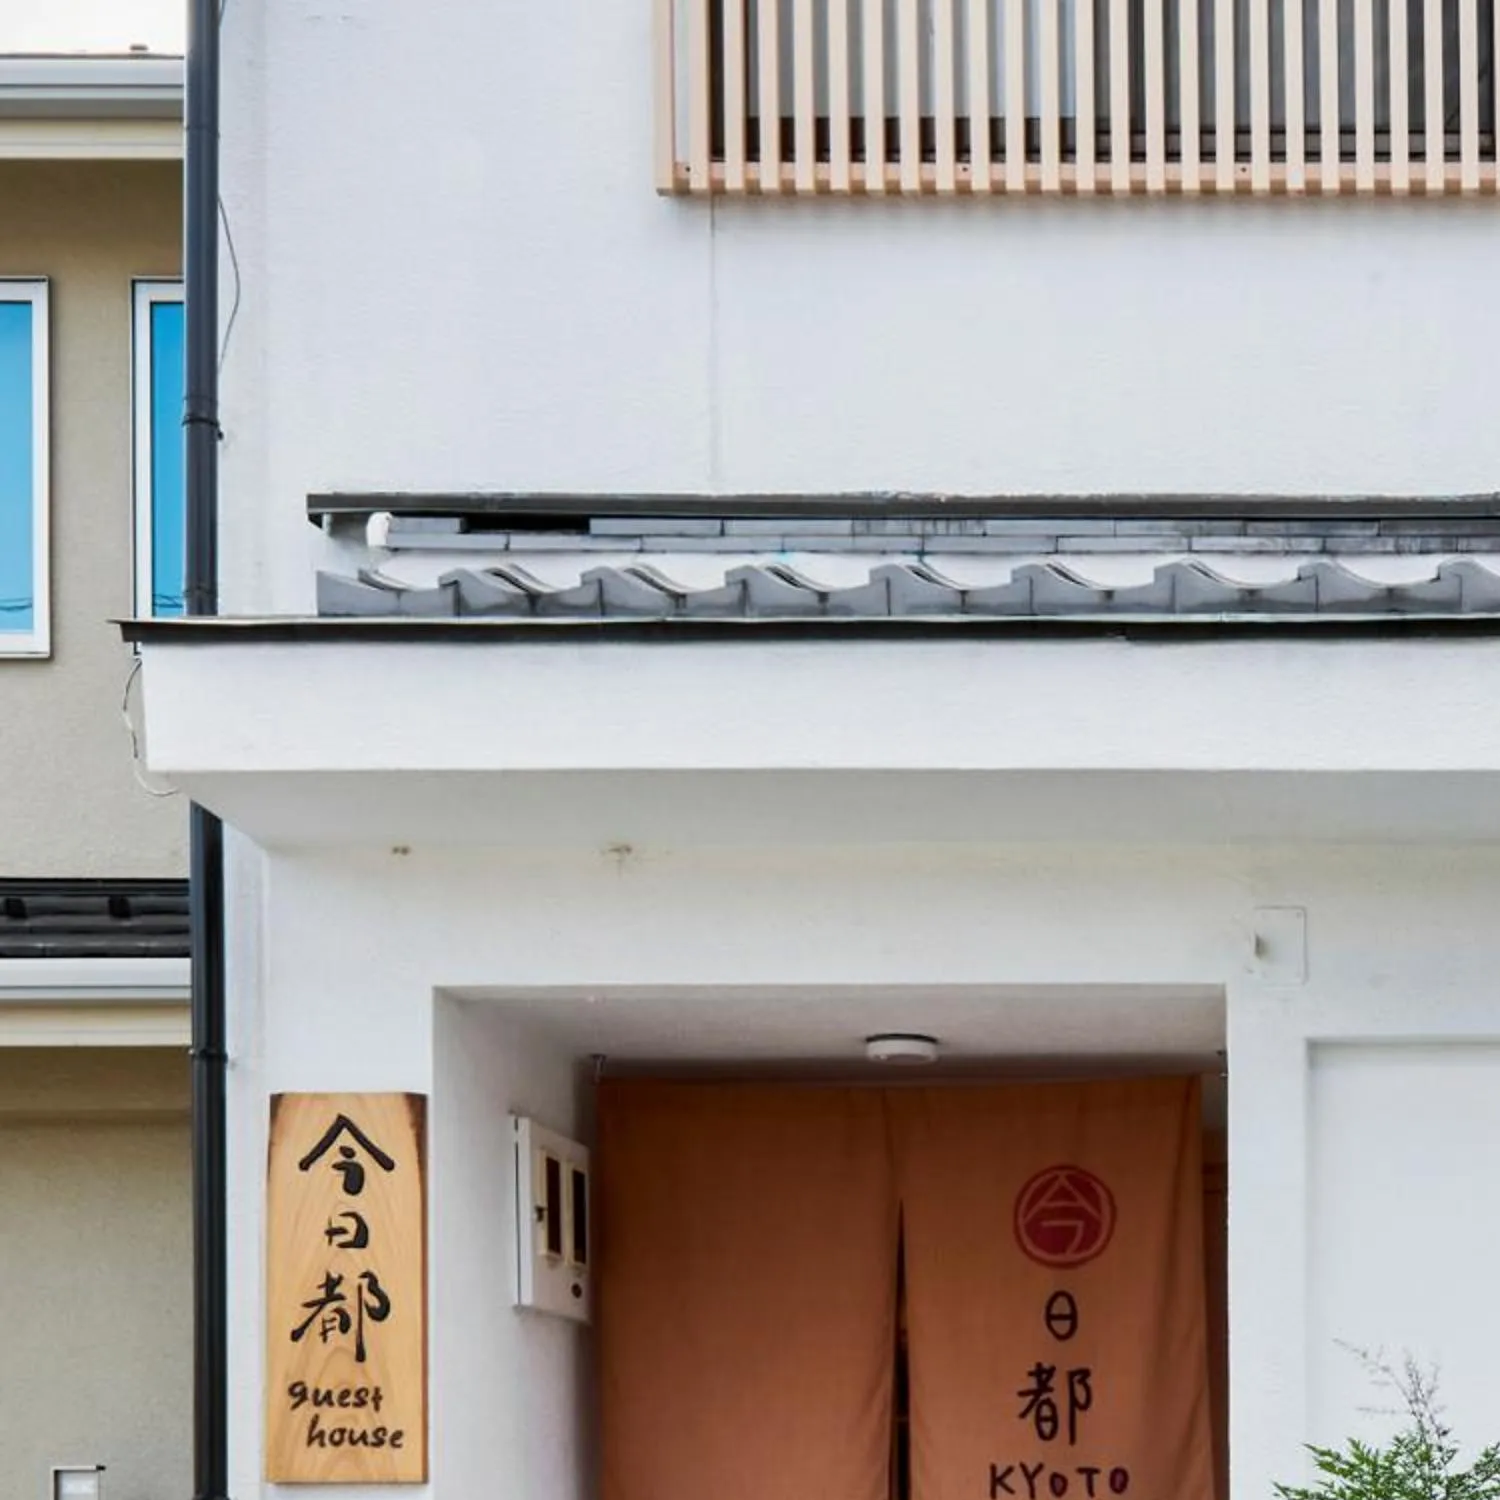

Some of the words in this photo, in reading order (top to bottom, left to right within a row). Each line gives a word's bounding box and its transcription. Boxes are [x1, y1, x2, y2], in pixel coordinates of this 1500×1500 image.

[290, 1113, 396, 1364] 今日都
[287, 1381, 384, 1412] guest
[306, 1414, 404, 1449] house
[989, 1462, 1130, 1500] KYOTO
